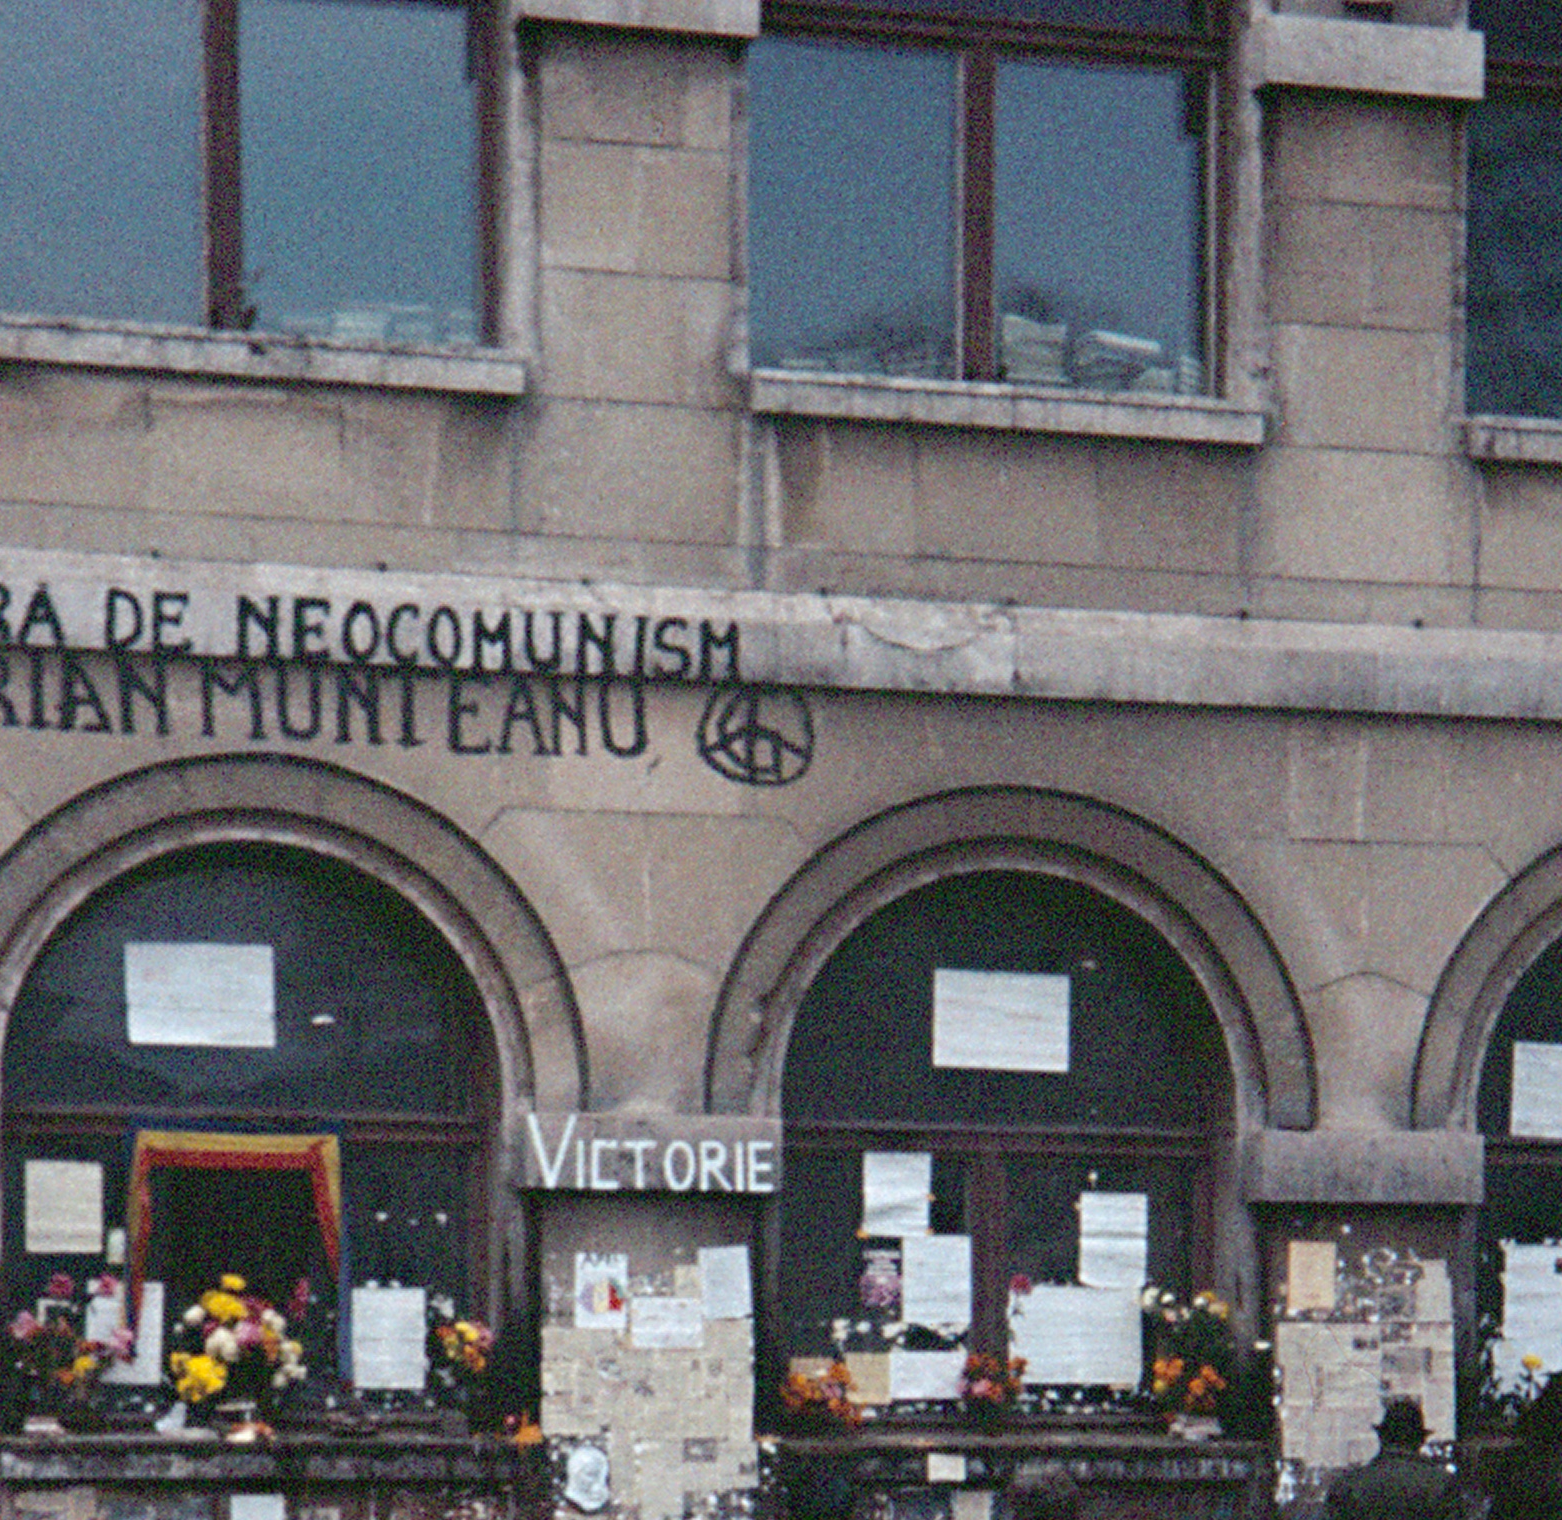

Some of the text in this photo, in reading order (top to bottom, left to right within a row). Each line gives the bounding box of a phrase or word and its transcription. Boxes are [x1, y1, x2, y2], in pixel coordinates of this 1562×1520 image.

[104, 586, 195, 657] DE
[237, 594, 741, 684] NEOCOMUNISM
[200, 664, 649, 757] MUNTEANU
[526, 1111, 776, 1193] VICTORIE
